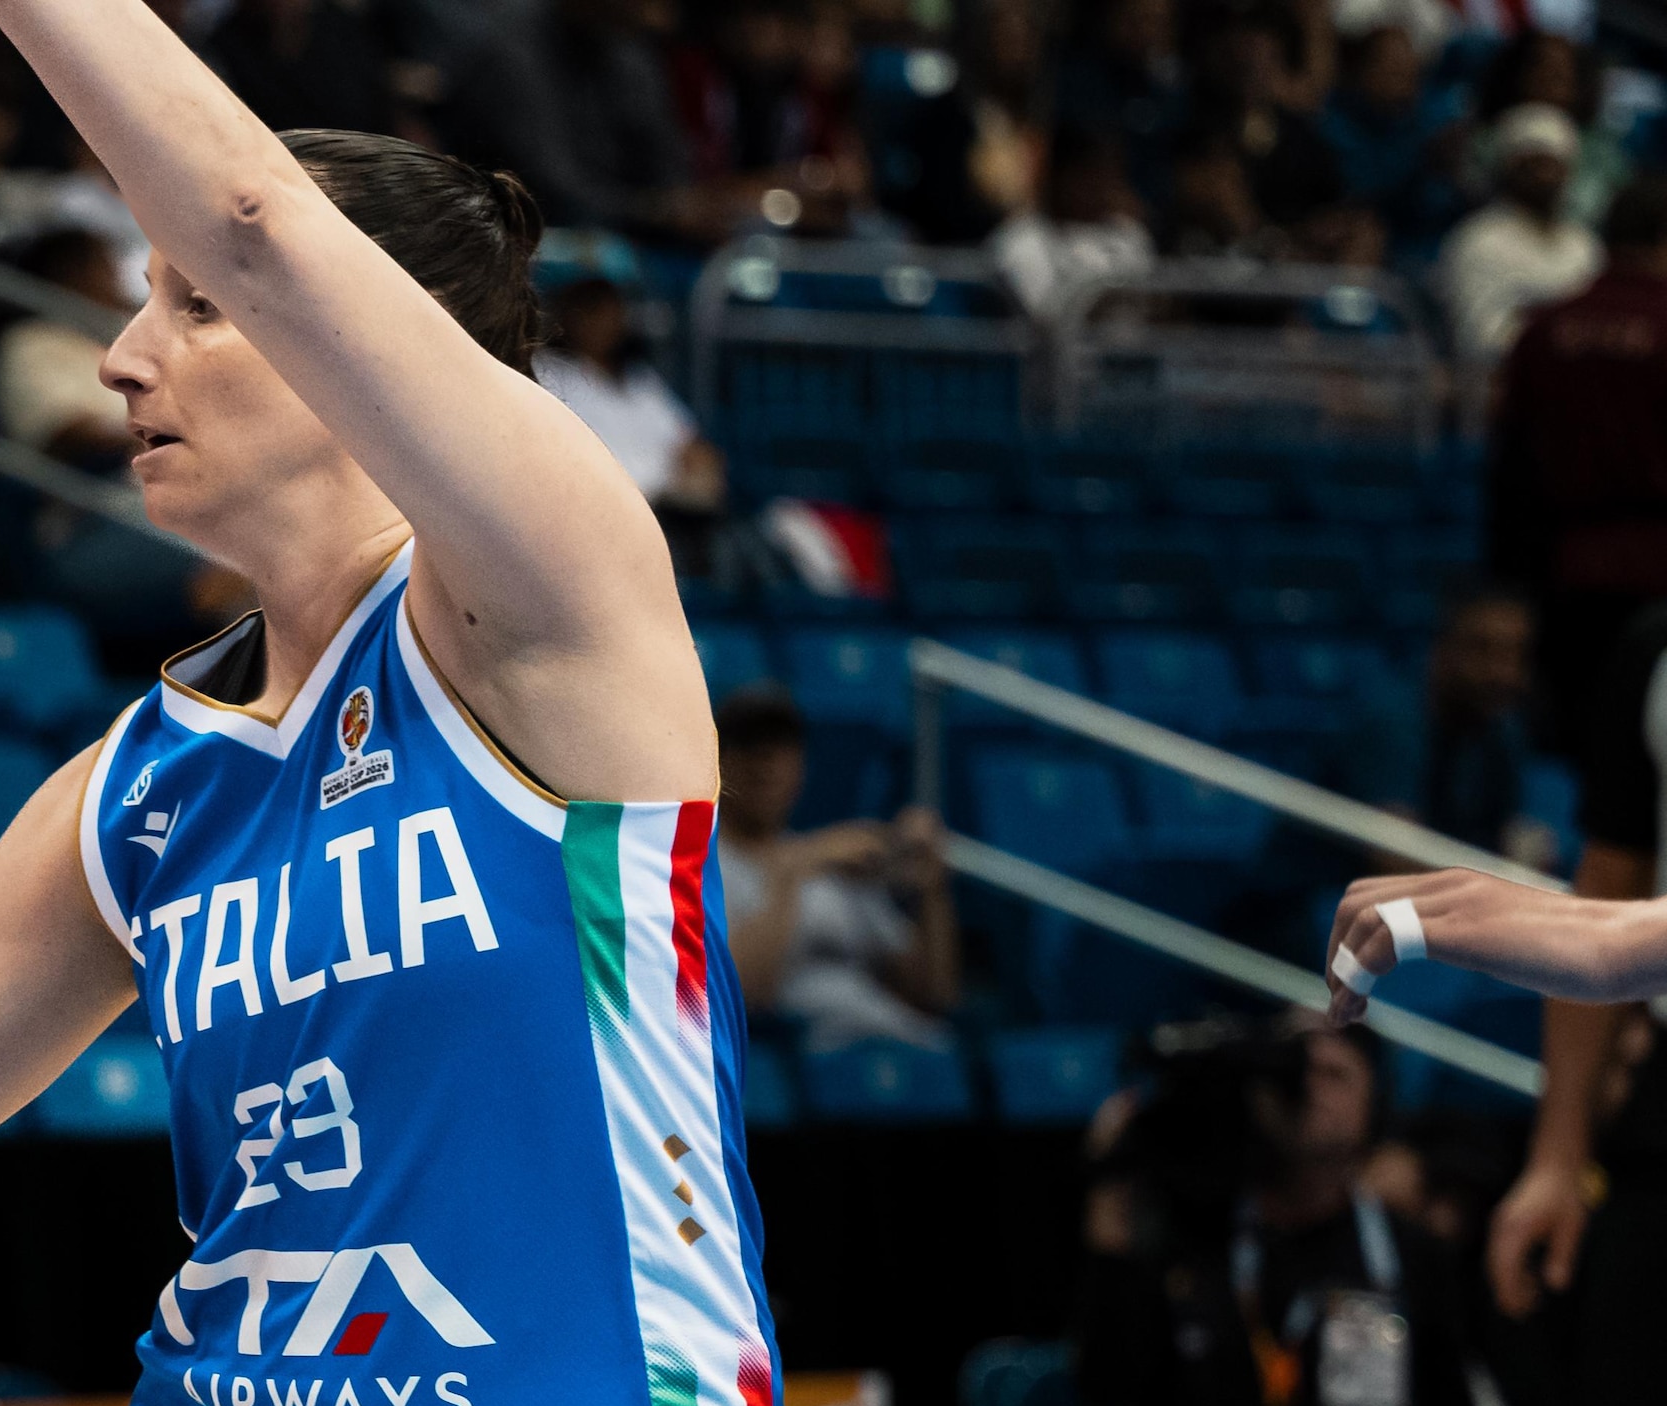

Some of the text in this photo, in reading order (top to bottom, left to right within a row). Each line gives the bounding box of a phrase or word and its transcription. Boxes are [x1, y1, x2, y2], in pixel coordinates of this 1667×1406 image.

[365, 762, 389, 777] 2026
[233, 1056, 364, 1211] 23
[159, 1243, 497, 1357] ITA
